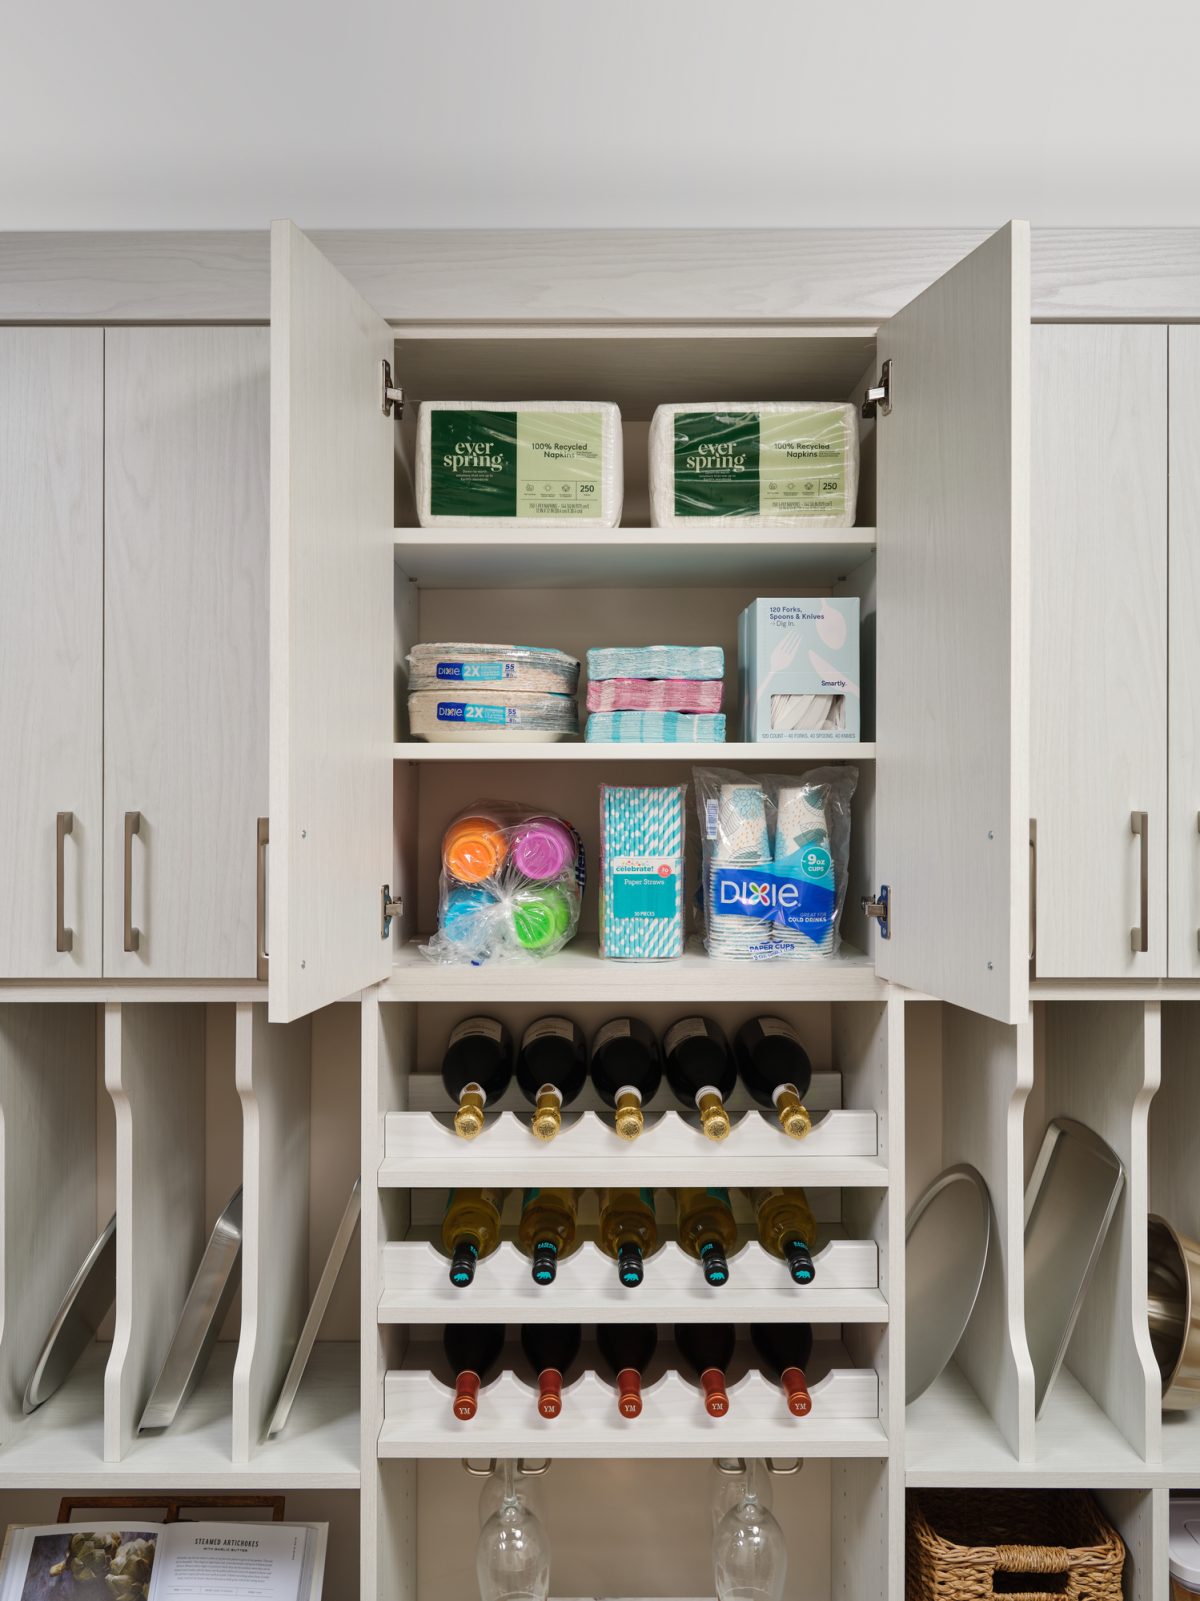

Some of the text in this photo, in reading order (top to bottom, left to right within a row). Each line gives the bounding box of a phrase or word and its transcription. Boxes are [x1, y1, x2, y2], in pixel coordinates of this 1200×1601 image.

[455, 442, 494, 456] ever
[554, 443, 588, 451] Recycled
[698, 441, 737, 455] ever
[786, 451, 818, 459] Napkins
[443, 452, 504, 472] spring
[686, 452, 746, 473] spring
[580, 484, 595, 492] 250
[823, 482, 838, 490] 250
[776, 620, 787, 628] Dig
[464, 665, 480, 677] 2X
[466, 706, 484, 718] 2X
[624, 878, 642, 886] Paper
[543, 1405, 555, 1413] YM
[624, 1404, 636, 1412] YM
[223, 1539, 259, 1547] ARTICHOKES
